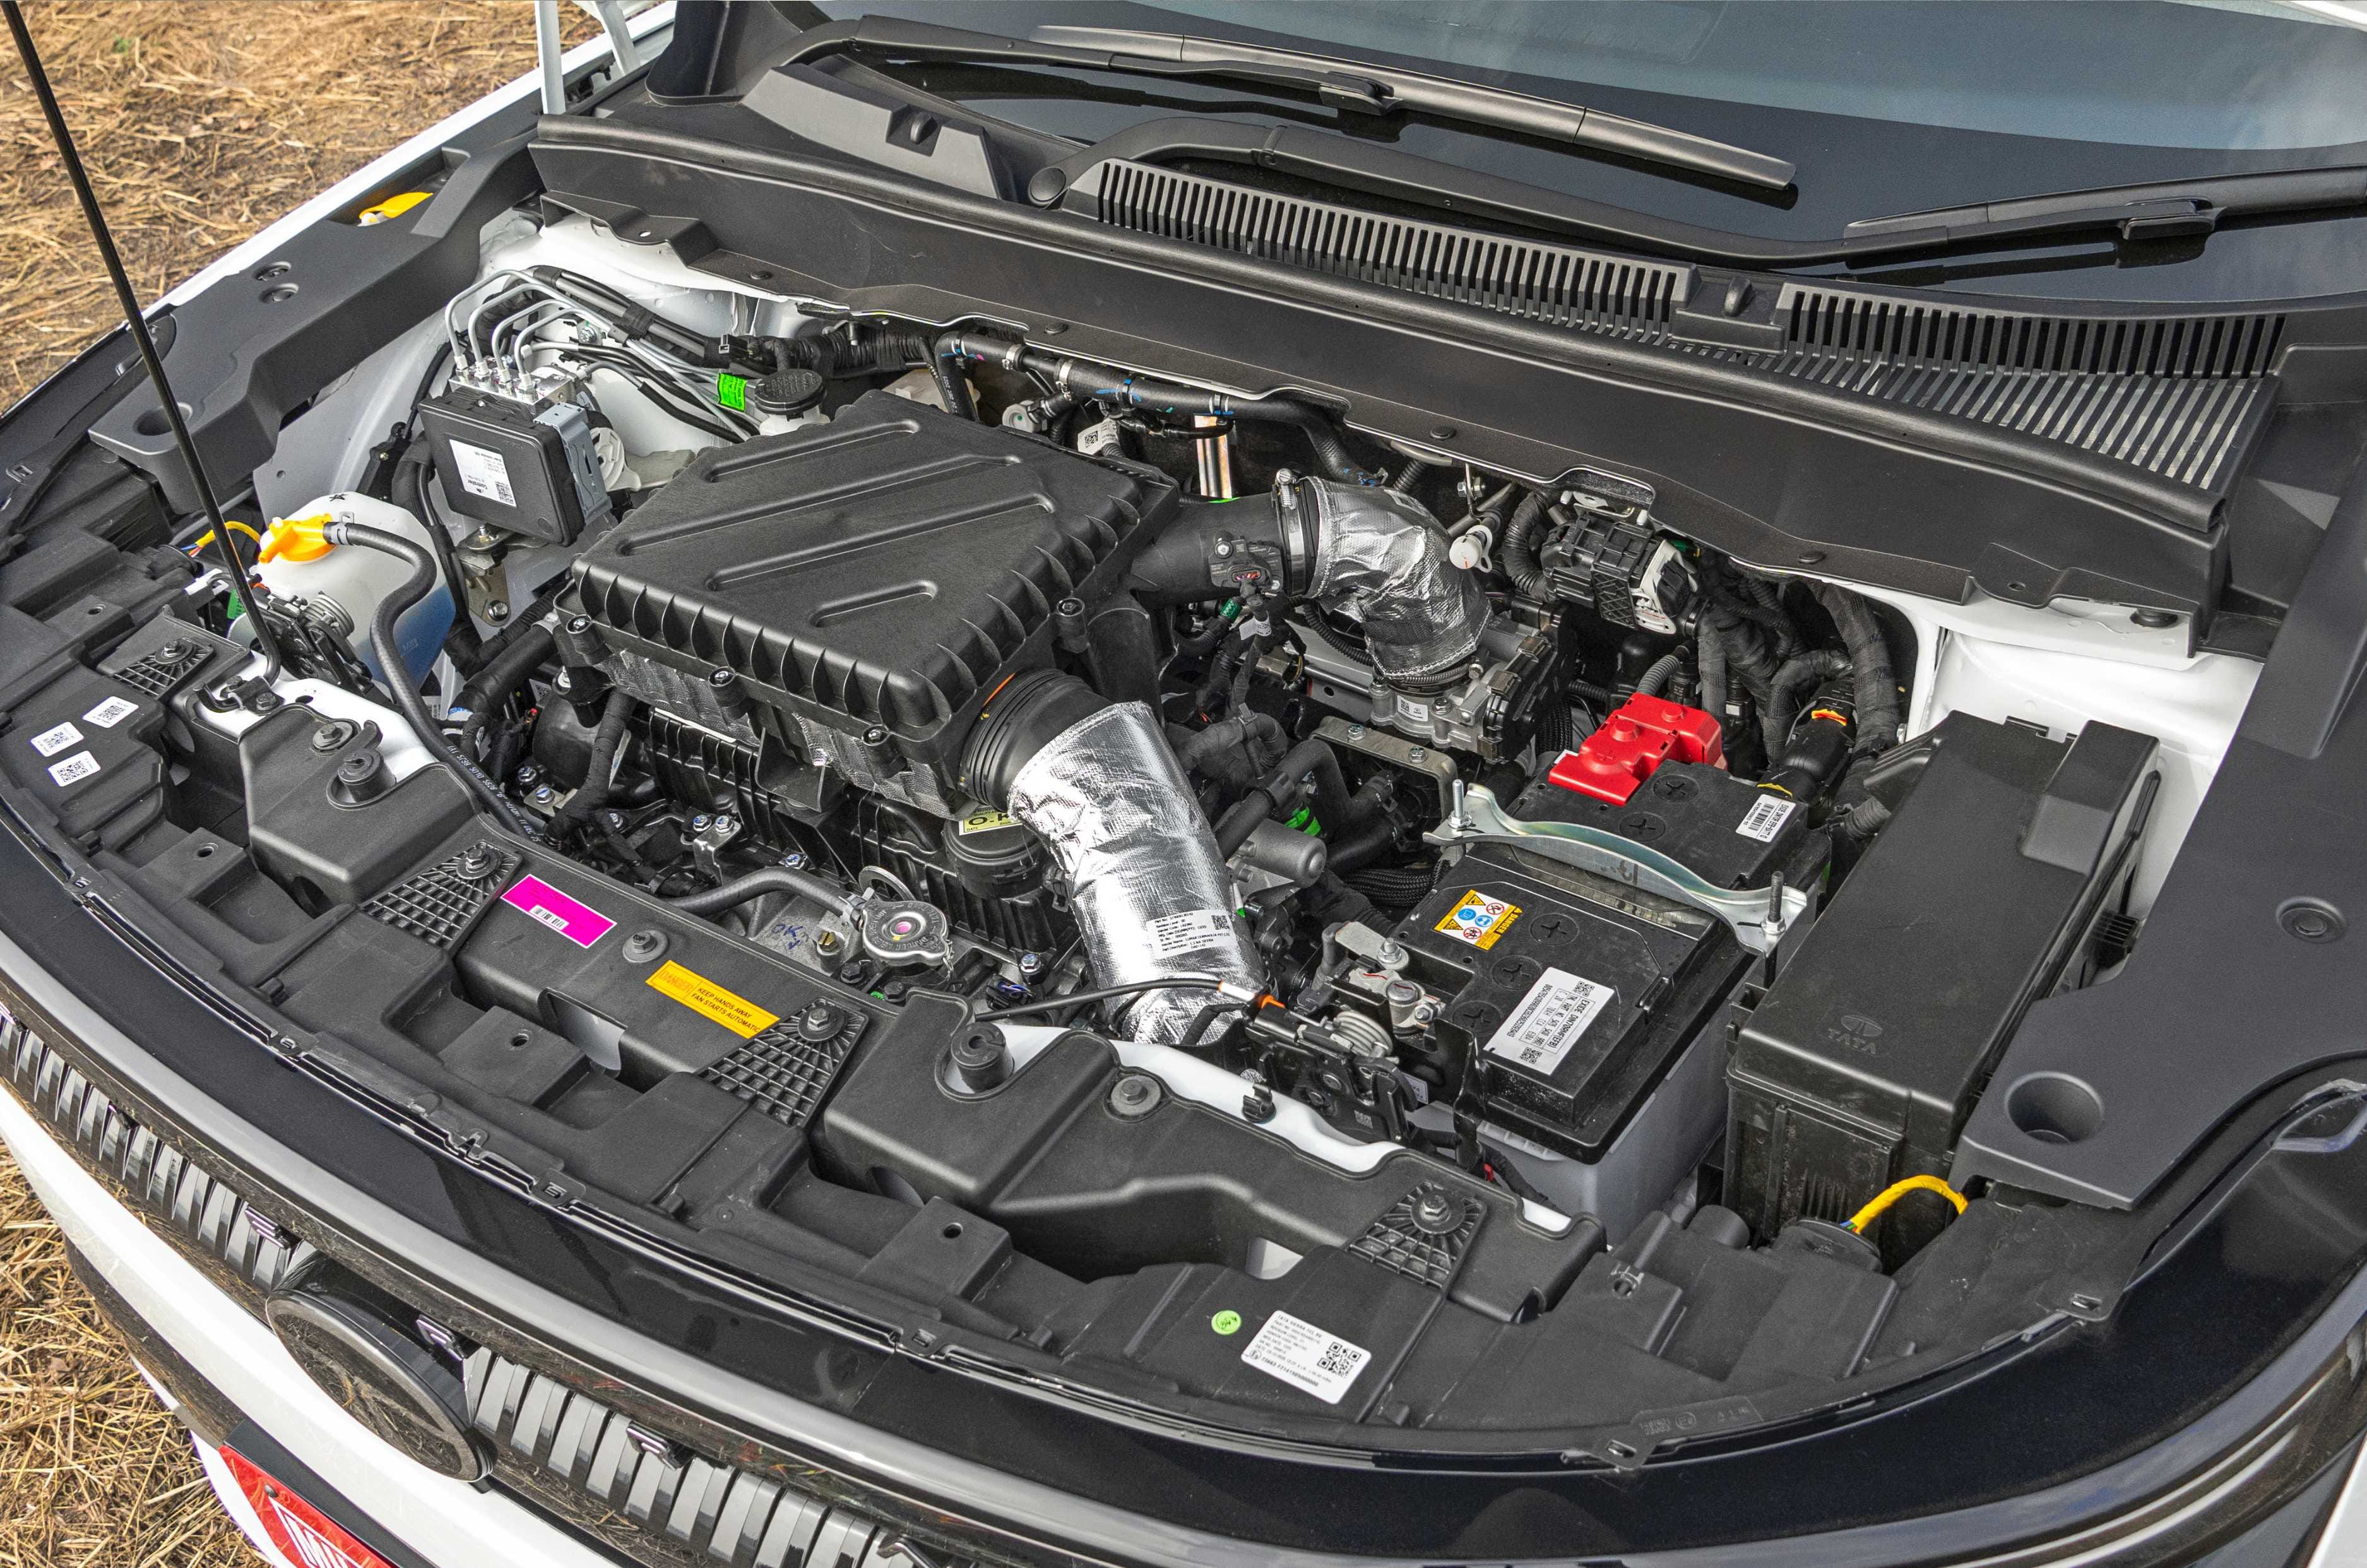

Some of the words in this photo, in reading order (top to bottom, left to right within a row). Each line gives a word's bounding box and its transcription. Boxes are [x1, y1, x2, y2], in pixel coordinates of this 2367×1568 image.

[1495, 913, 1517, 934] DANGER
[895, 937, 928, 950] DANGER
[690, 992, 706, 1002] FAN
[703, 999, 728, 1015] STARTS
[696, 987, 716, 999] KEEP
[712, 995, 737, 1010] HANDS
[733, 1007, 753, 1019] AWAY
[1573, 999, 1591, 1014] EXIDE
[1828, 1028, 1877, 1055] TATA
